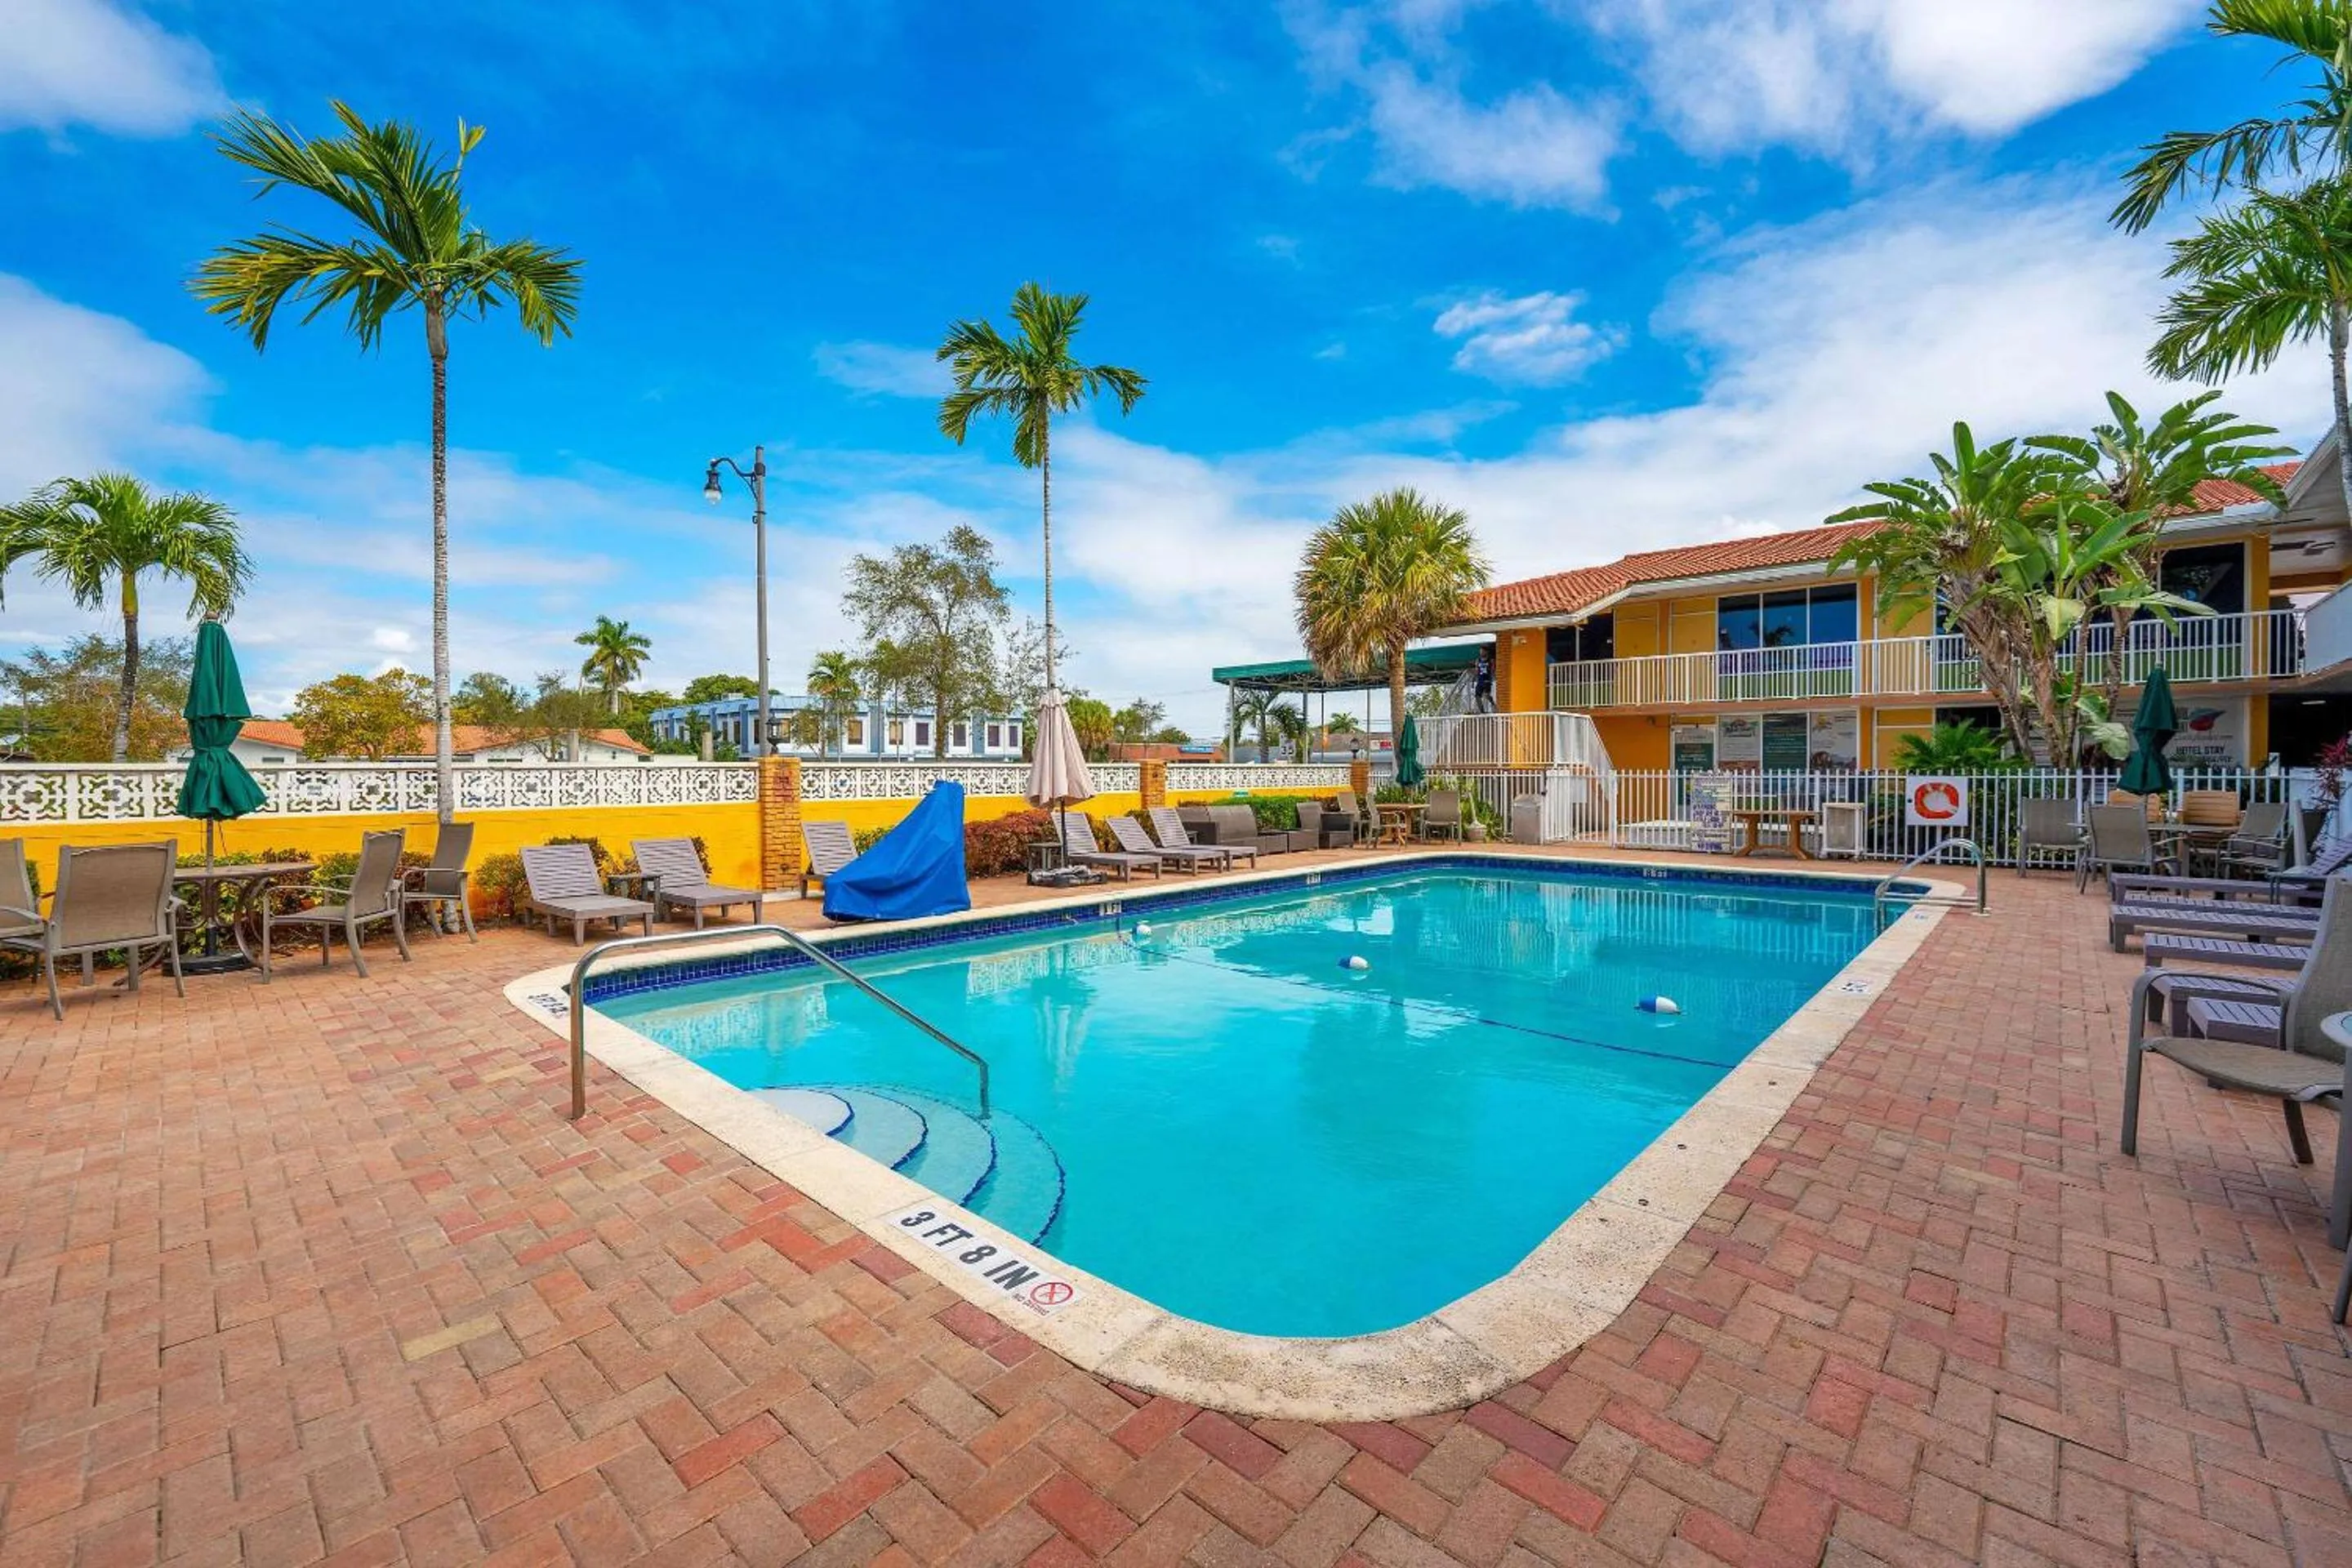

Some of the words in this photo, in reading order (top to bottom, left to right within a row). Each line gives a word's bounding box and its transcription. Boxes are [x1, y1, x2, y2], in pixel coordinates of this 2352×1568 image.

[2204, 746, 2225, 755] STAY
[901, 1211, 935, 1227] 3
[921, 1223, 974, 1247] FT
[959, 1245, 997, 1264] 8
[982, 1259, 1040, 1291] IN
[1012, 1293, 1025, 1302] NO
